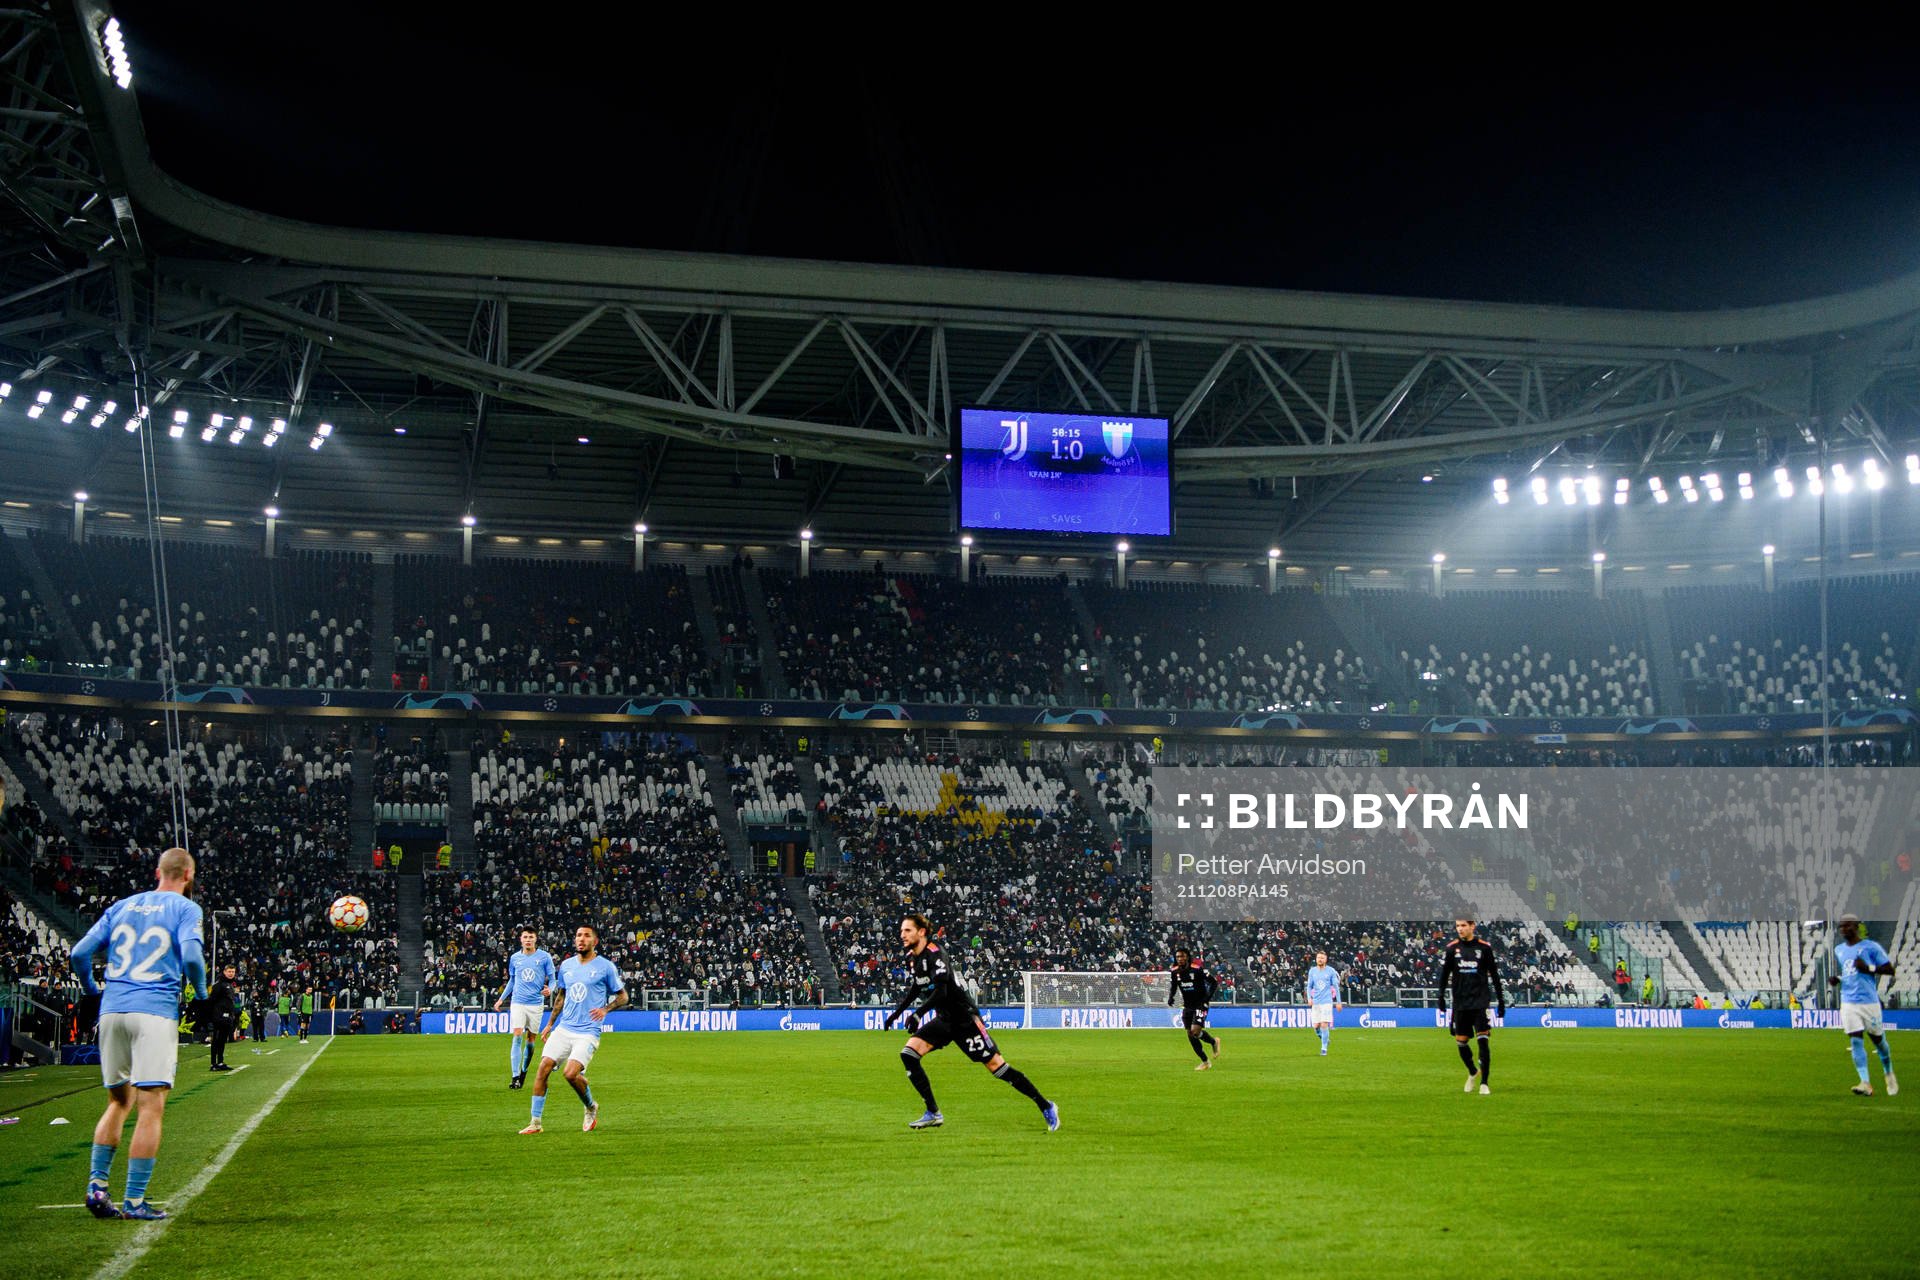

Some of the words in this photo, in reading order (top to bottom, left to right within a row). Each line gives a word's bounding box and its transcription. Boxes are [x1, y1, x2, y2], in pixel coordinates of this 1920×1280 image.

[1051, 439, 1083, 460] 1:0
[1051, 513, 1082, 524] SAVES
[107, 923, 171, 982] 32
[445, 1013, 512, 1033] GAZPRO
[660, 1011, 737, 1031] GAZPROM
[793, 1022, 820, 1030] GAZPROM
[1061, 1009, 1133, 1028] GAZPROM
[1615, 1009, 1682, 1028] GAZPROM
[1792, 1010, 1842, 1029] GAZPRO
[966, 1035, 985, 1052] 25
